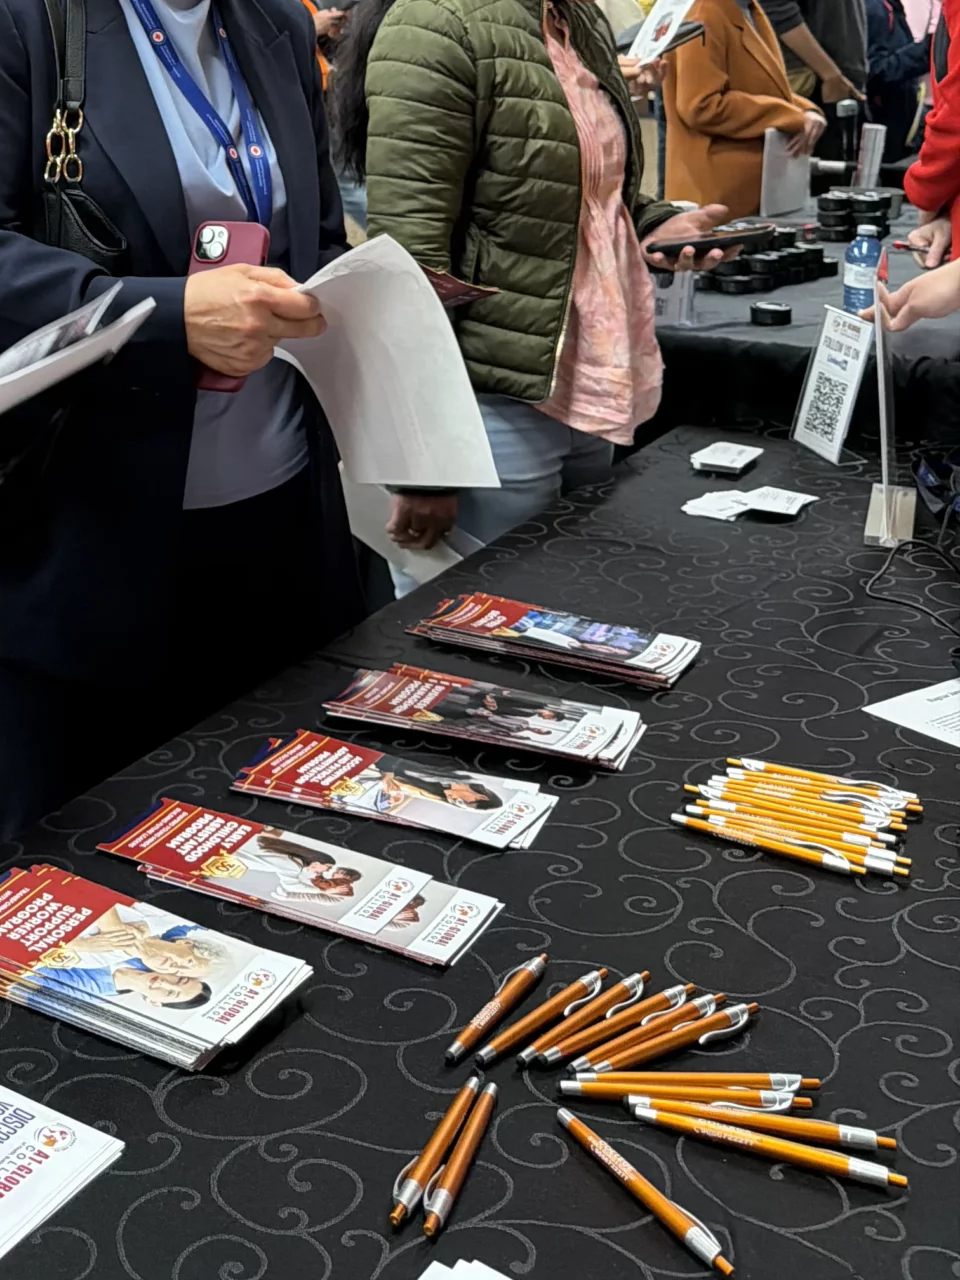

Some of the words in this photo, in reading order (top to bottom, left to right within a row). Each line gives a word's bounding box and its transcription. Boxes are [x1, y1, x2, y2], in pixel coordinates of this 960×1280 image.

[293, 750, 332, 774] PROGRAM
[163, 812, 215, 849] PROGRAM
[173, 816, 228, 855] ASSISTANT
[181, 820, 241, 863] CHILDHOOD
[217, 824, 253, 848] EARLY
[2, 900, 64, 941] WORKER
[364, 891, 401, 921] A1-GLOBAL
[14, 904, 79, 947] SUPPORT
[24, 906, 94, 954] PERSONAL
[425, 914, 456, 945] COLLEGE
[433, 917, 468, 948] A1-GLOBAL
[204, 984, 249, 1021] COLLEGE
[212, 987, 260, 1026] A1-GLOBAL
